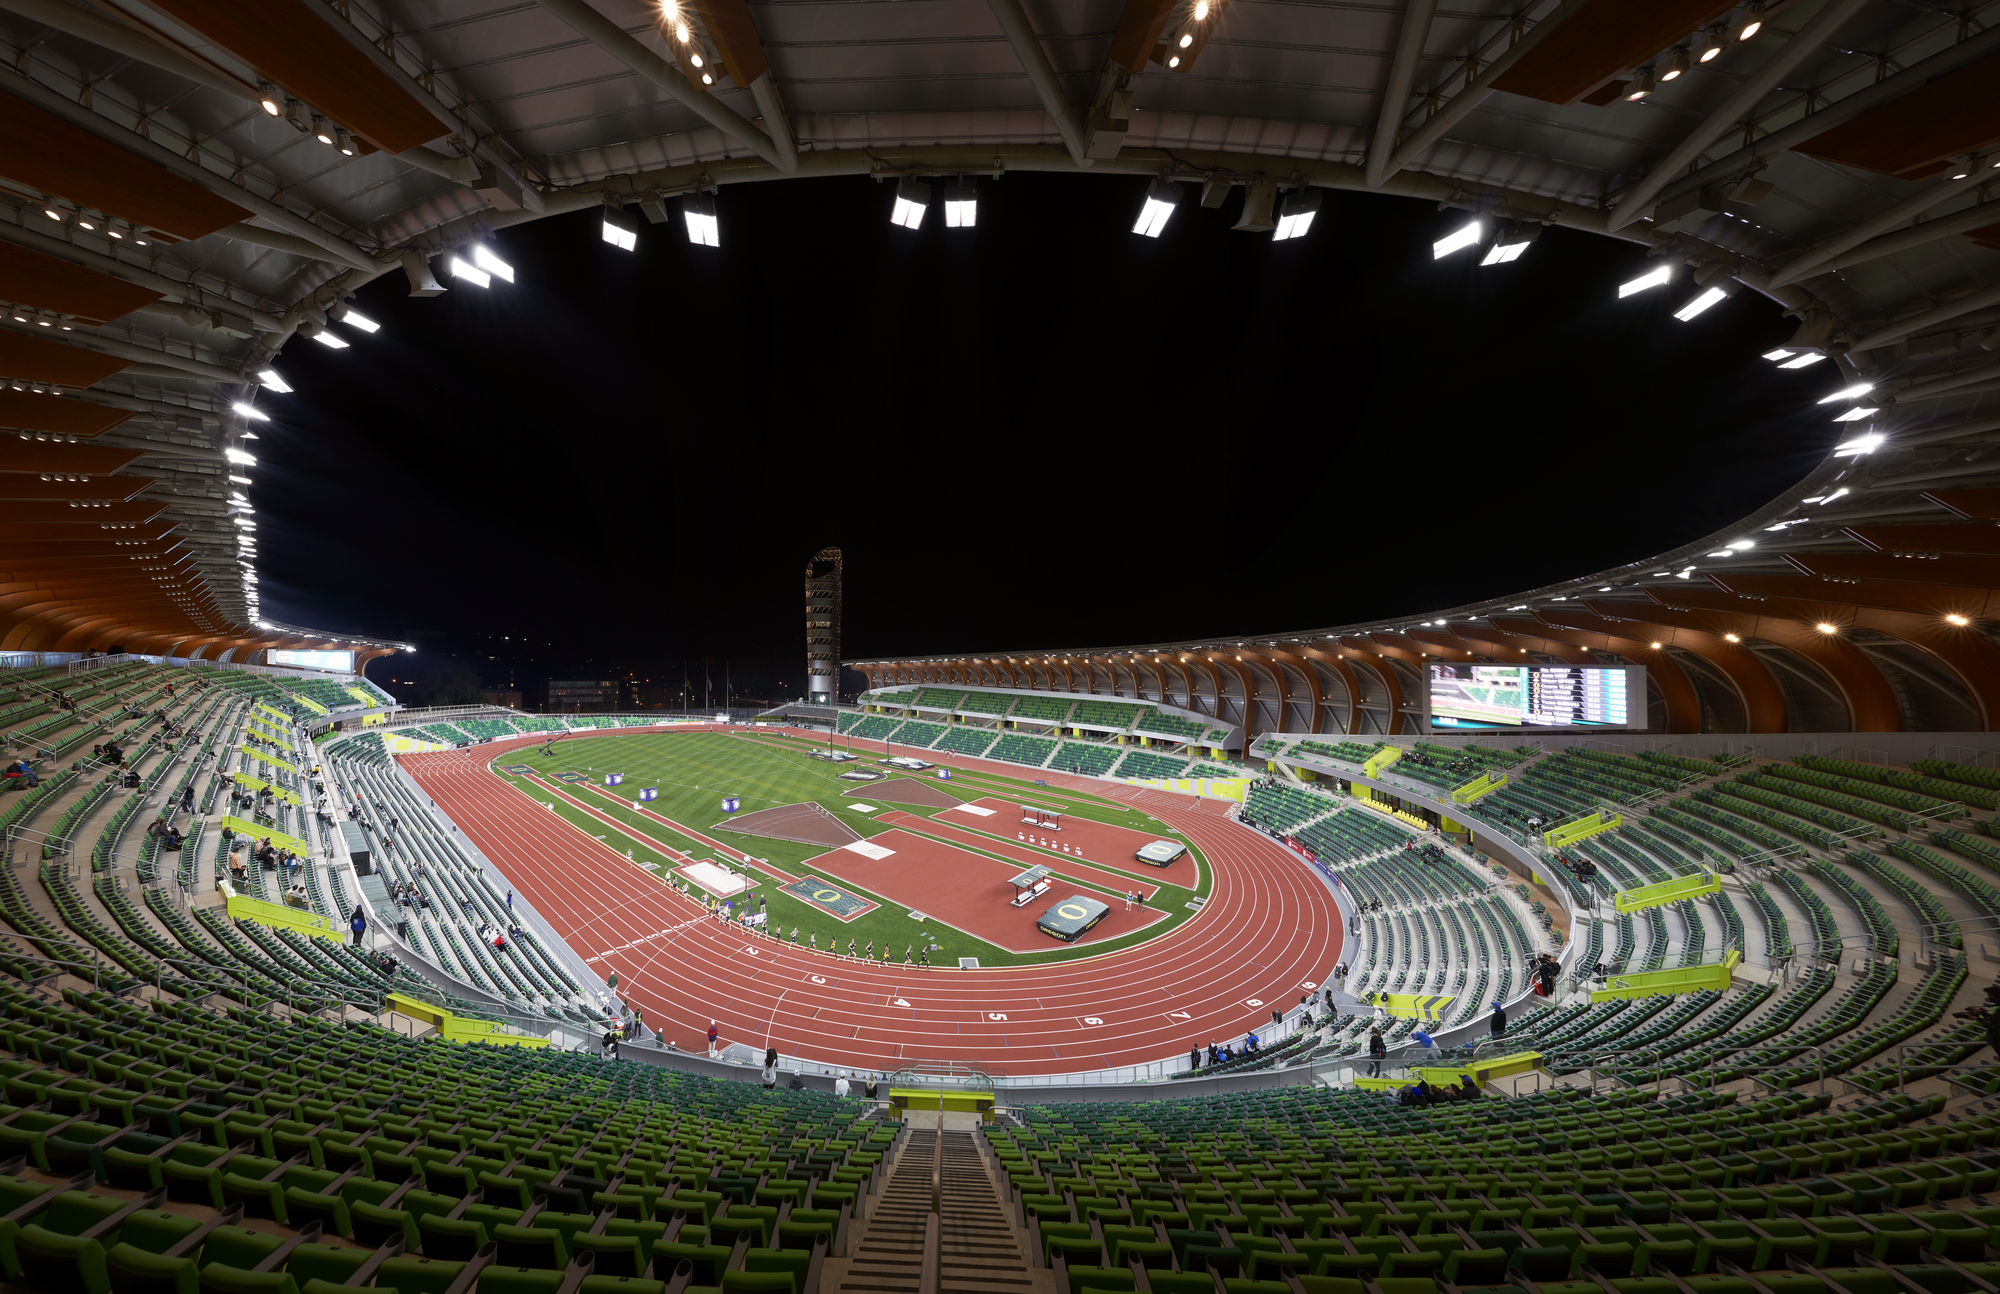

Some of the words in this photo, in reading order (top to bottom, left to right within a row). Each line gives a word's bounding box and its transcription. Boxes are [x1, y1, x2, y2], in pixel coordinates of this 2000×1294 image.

[1057, 904, 1087, 920] O
[1040, 925, 1066, 939] OREGON
[745, 946, 759, 956] 2
[811, 975, 826, 985] 3
[1301, 981, 1318, 989] 9
[893, 998, 911, 1008] 4
[1246, 998, 1264, 1007] 8
[988, 1012, 1008, 1021] 5
[1169, 1011, 1192, 1019] 7
[1084, 1017, 1104, 1026] 6
